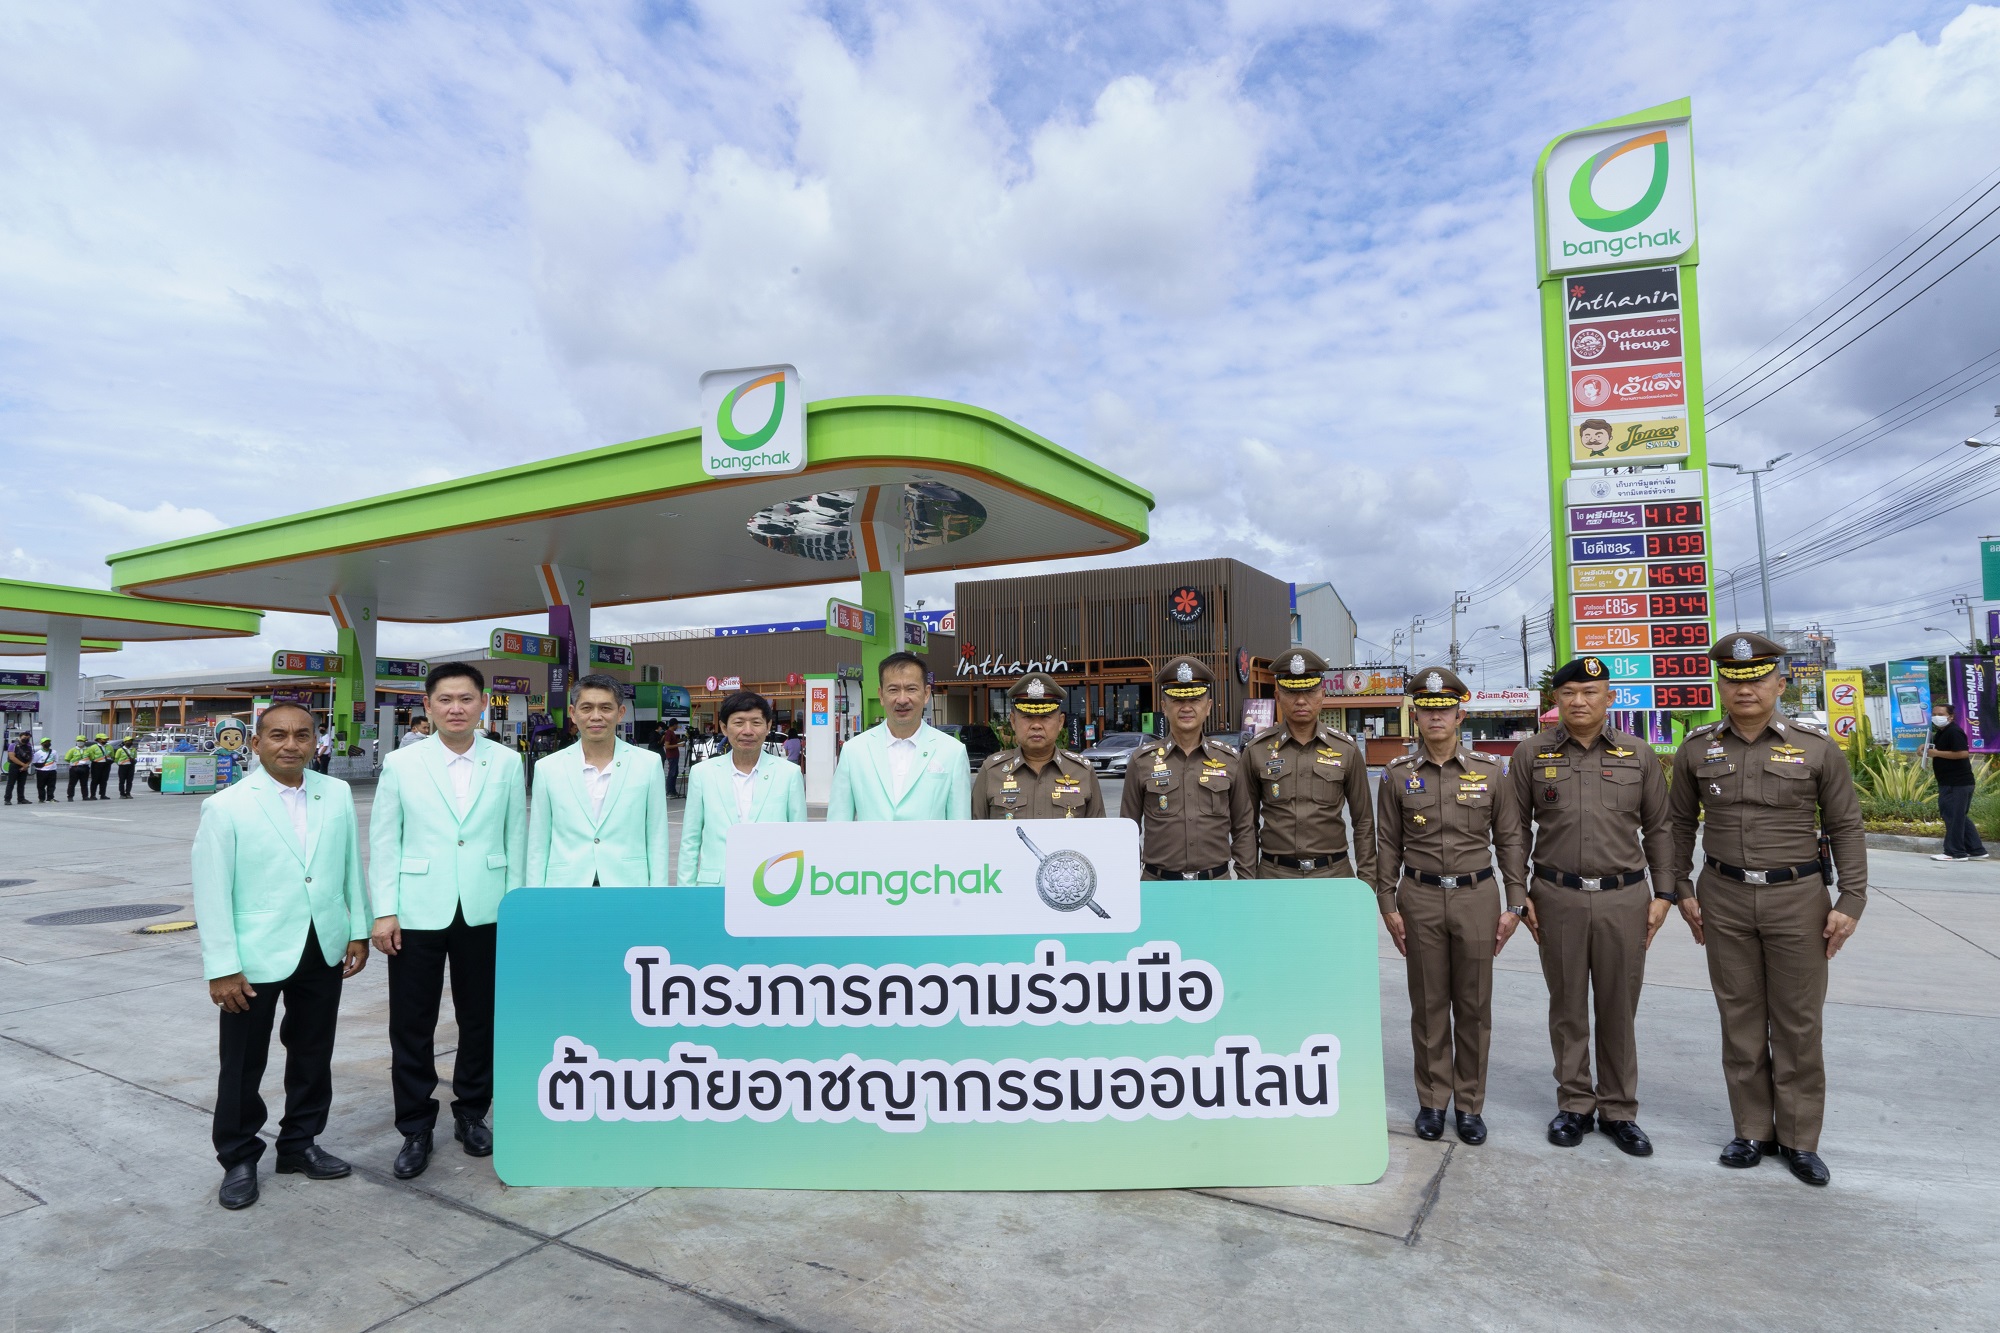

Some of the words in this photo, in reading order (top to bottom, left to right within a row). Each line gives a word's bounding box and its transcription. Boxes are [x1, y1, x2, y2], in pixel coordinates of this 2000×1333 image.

[1562, 228, 1682, 257] bangchak
[1568, 291, 1678, 312] Inthanin
[1607, 327, 1678, 342] Gateaux
[1619, 339, 1671, 351] House
[1646, 440, 1681, 449] SALAD
[710, 450, 791, 472] bangchak
[1645, 505, 1701, 524] 41.21
[1648, 535, 1703, 555] 31.99
[1614, 568, 1643, 587] 97
[1648, 565, 1705, 585] 46.49
[577, 579, 585, 596] 2
[362, 607, 370, 621] 3
[832, 606, 837, 624] 1
[1171, 606, 1202, 621] Inthanin
[1651, 596, 1706, 615] 33.44
[495, 635, 502, 648] 3
[1653, 625, 1708, 646] 32.99
[277, 655, 285, 667] 5
[626, 652, 632, 663] 4
[956, 653, 1069, 677] Inthanin
[1655, 656, 1710, 676] 35.03
[420, 666, 427, 675] 6
[517, 679, 530, 693] 97
[1476, 691, 1500, 700] Siam
[1965, 663, 1979, 720] PREMIUM
[298, 691, 313, 702] 97
[1656, 687, 1711, 706] 35.30
[810, 863, 1003, 906] bangchak
[634, 948, 1214, 1016] โครงการความร่วมมือ
[547, 1044, 1331, 1121] ต้านภัยอาชญากรรมออนไลน์
